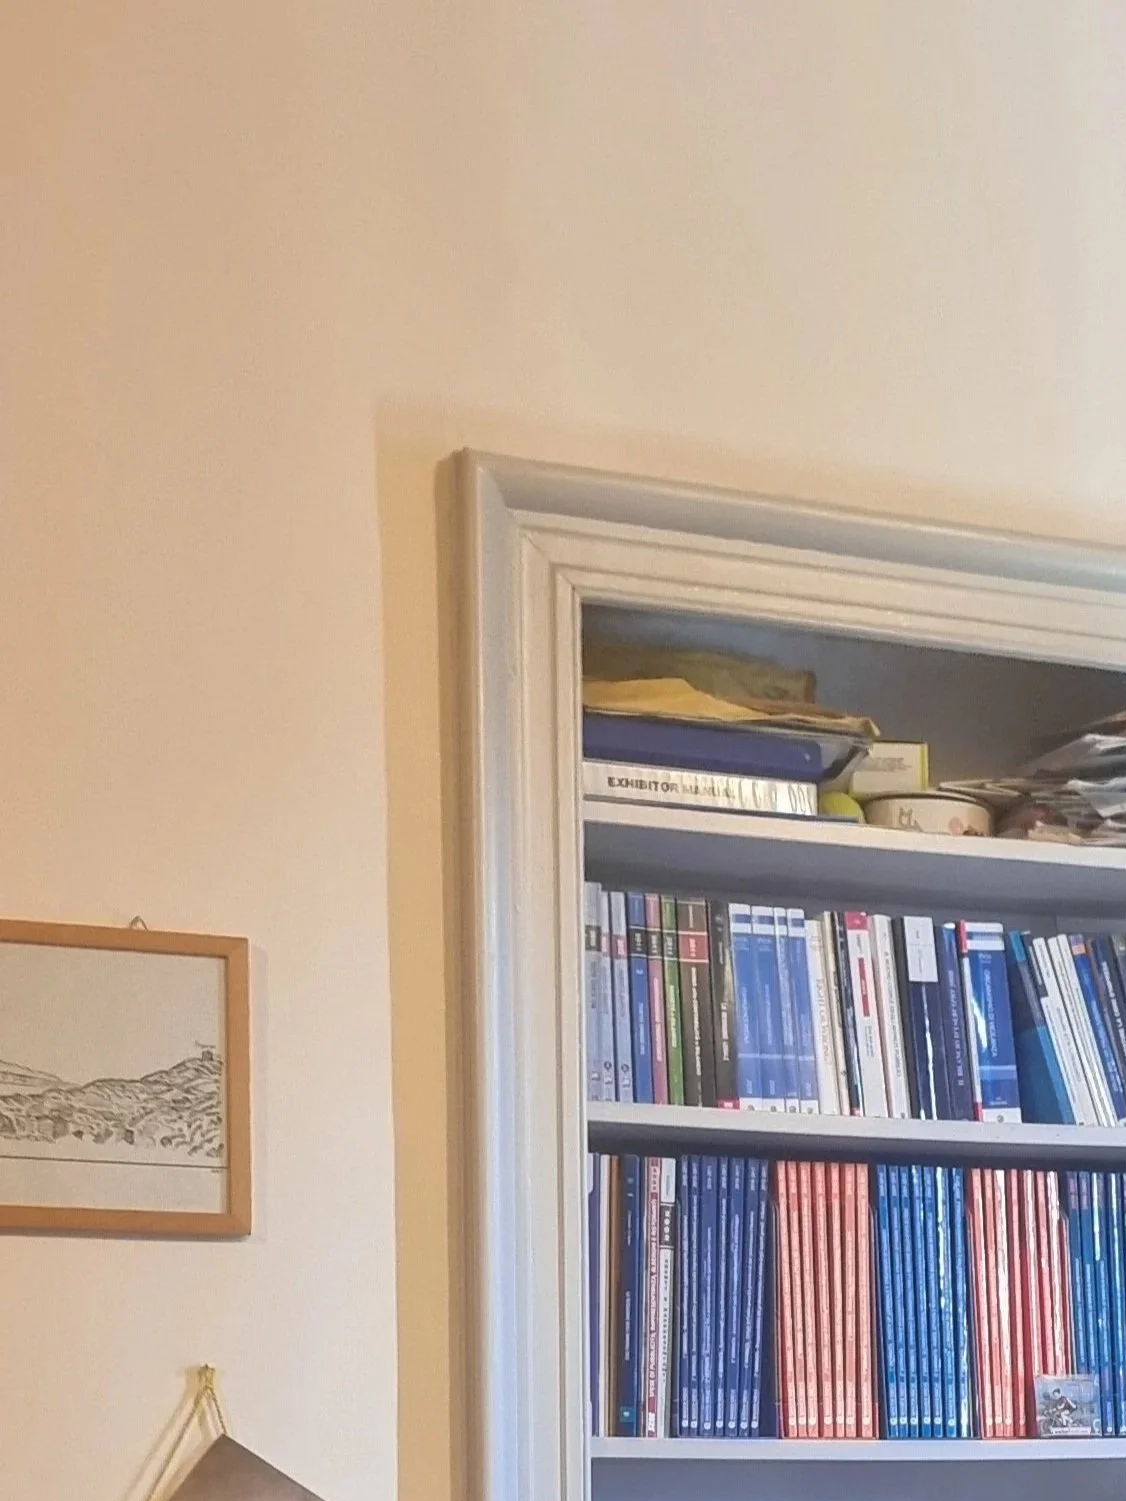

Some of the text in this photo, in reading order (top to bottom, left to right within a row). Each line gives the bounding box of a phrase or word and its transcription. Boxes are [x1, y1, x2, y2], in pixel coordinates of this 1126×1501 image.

[607, 776, 679, 794] EXHIBITOR
[982, 968, 995, 1013] ORGANISMO
[987, 1020, 999, 1057] VIGILANZA
